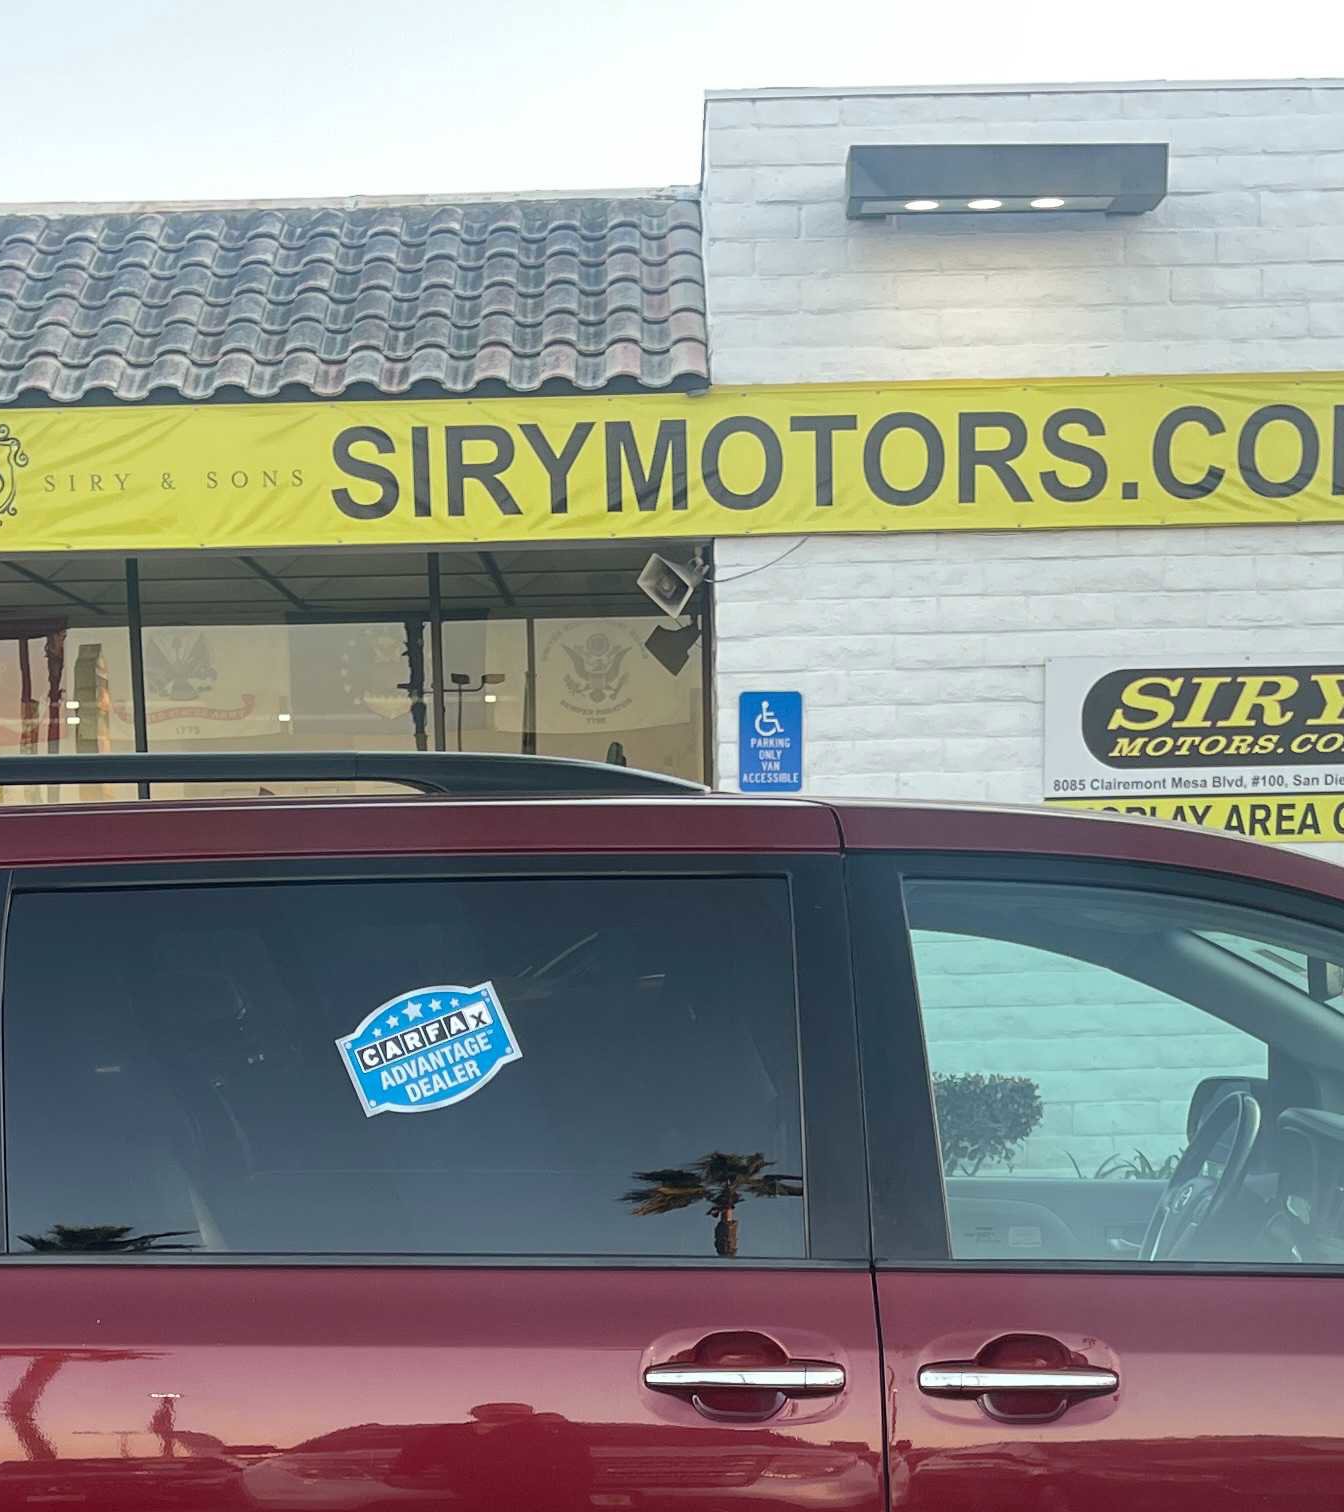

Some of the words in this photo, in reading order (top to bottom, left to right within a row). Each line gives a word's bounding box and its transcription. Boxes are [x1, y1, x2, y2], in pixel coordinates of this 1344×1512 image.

[43, 472, 131, 493] SIRY
[161, 472, 176, 490] &
[207, 468, 305, 489] SONS
[750, 738, 791, 748] PARKING
[758, 749, 783, 760] ONLY
[761, 761, 781, 771] VAN
[742, 772, 799, 784] ACCESSIBLE
[1053, 778, 1086, 792] 8085
[1090, 775, 1167, 791] Clairemont
[1171, 776, 1207, 789] Mesa
[1293, 773, 1320, 787] San
[1223, 802, 1321, 837] AREA
[361, 1010, 488, 1067] CARFAX
[380, 1033, 493, 1090] ADVANTAGE
[405, 1059, 482, 1103] DEALER
